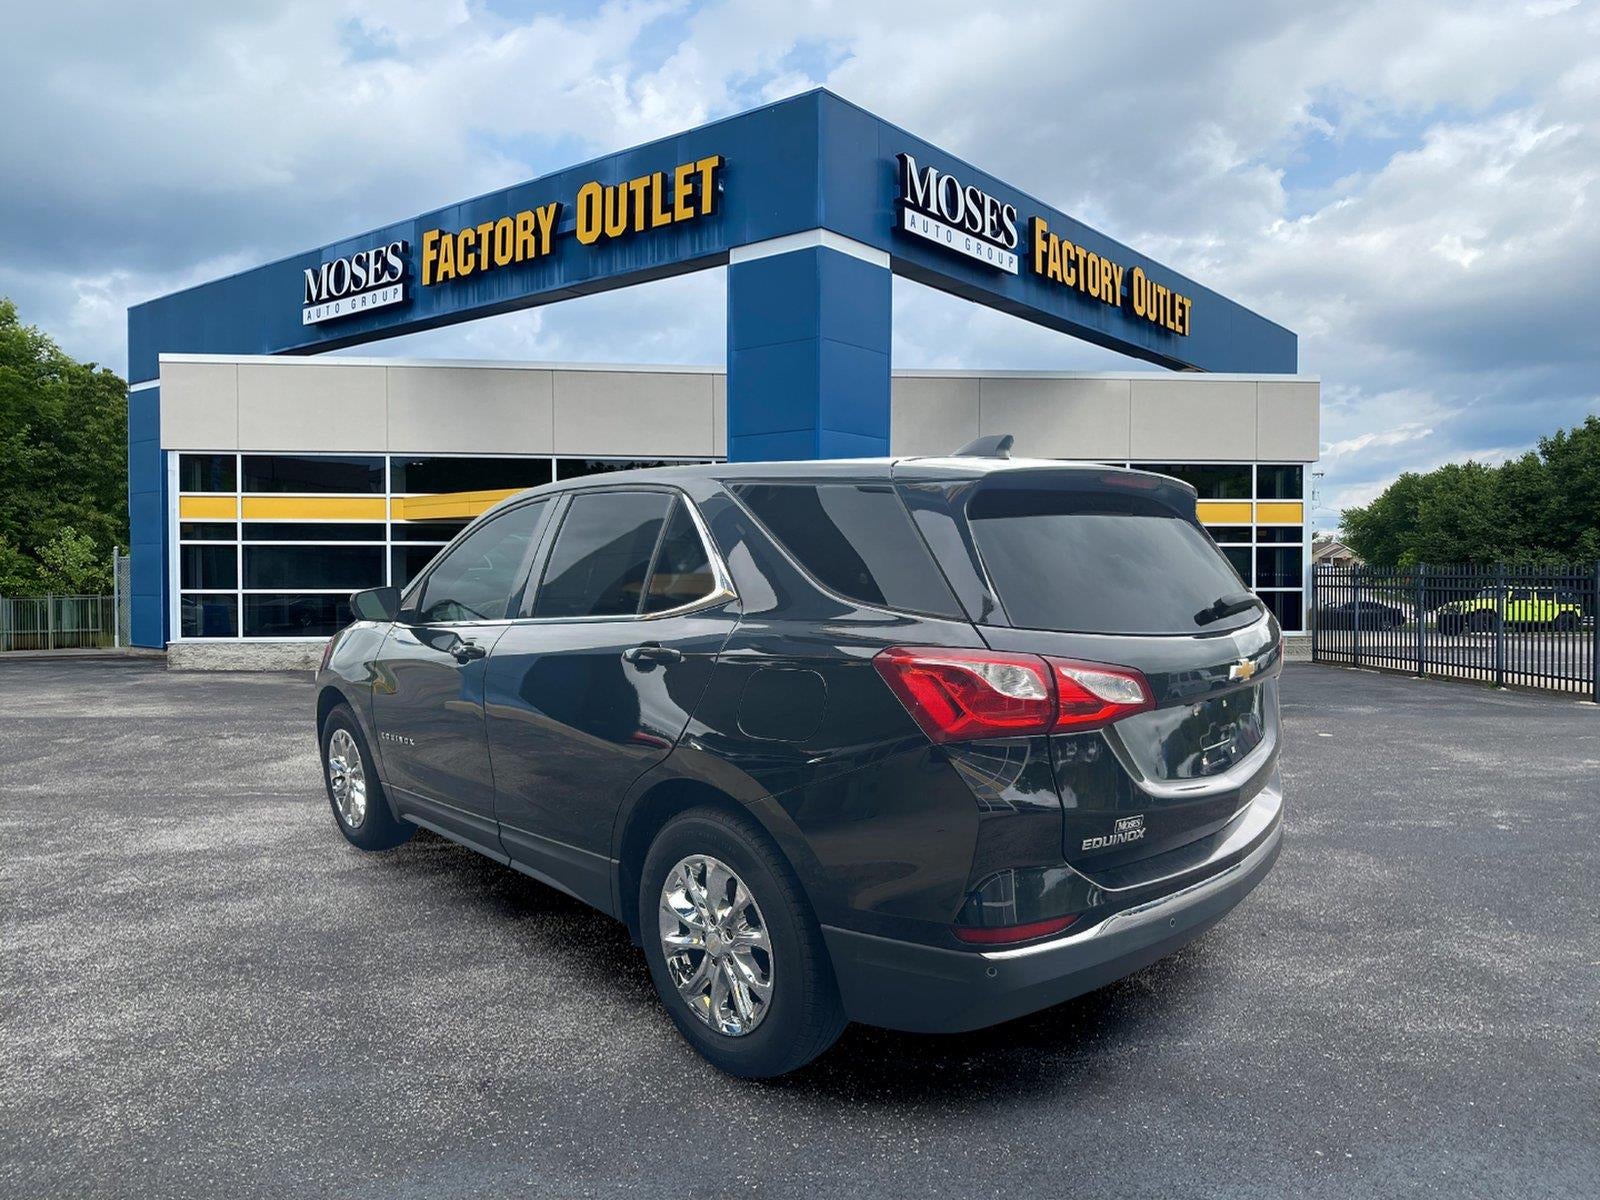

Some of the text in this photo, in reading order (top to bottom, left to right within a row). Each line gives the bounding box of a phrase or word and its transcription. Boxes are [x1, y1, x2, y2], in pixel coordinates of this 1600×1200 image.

[422, 155, 720, 286] FACTORY OUTLET
[903, 153, 1019, 249] MOSES
[303, 240, 405, 305] MOSES
[910, 214, 1014, 268] AUTO GROUP
[306, 288, 400, 322] AUTO GROUP
[1034, 216, 1192, 337] FACTORY OUTLET
[1081, 827, 1146, 851] EQUINOX
